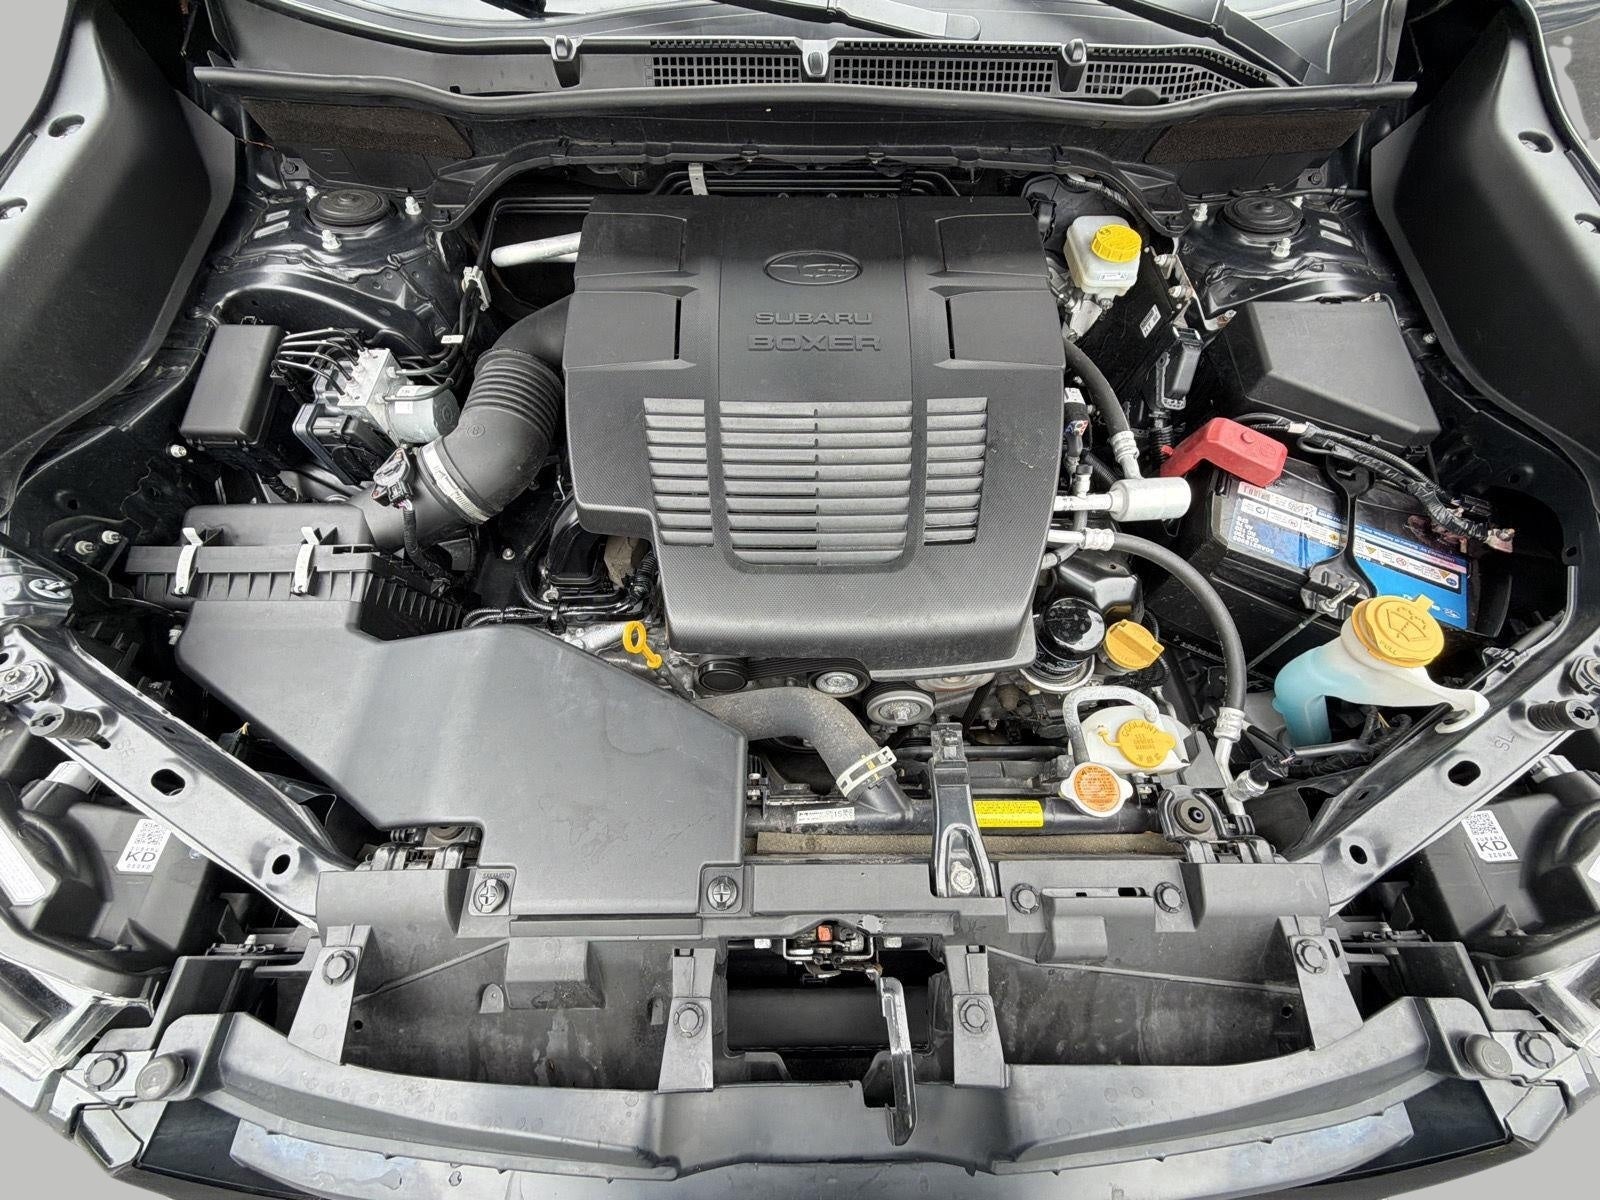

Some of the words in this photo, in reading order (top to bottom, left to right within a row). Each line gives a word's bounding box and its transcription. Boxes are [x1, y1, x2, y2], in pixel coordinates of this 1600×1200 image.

[755, 311, 873, 325] SUBARU
[748, 334, 882, 352] BOXER
[1121, 721, 1160, 737] COOLANT
[1494, 735, 1515, 752] SL
[1477, 840, 1508, 852] KD
[125, 851, 157, 863] KD
